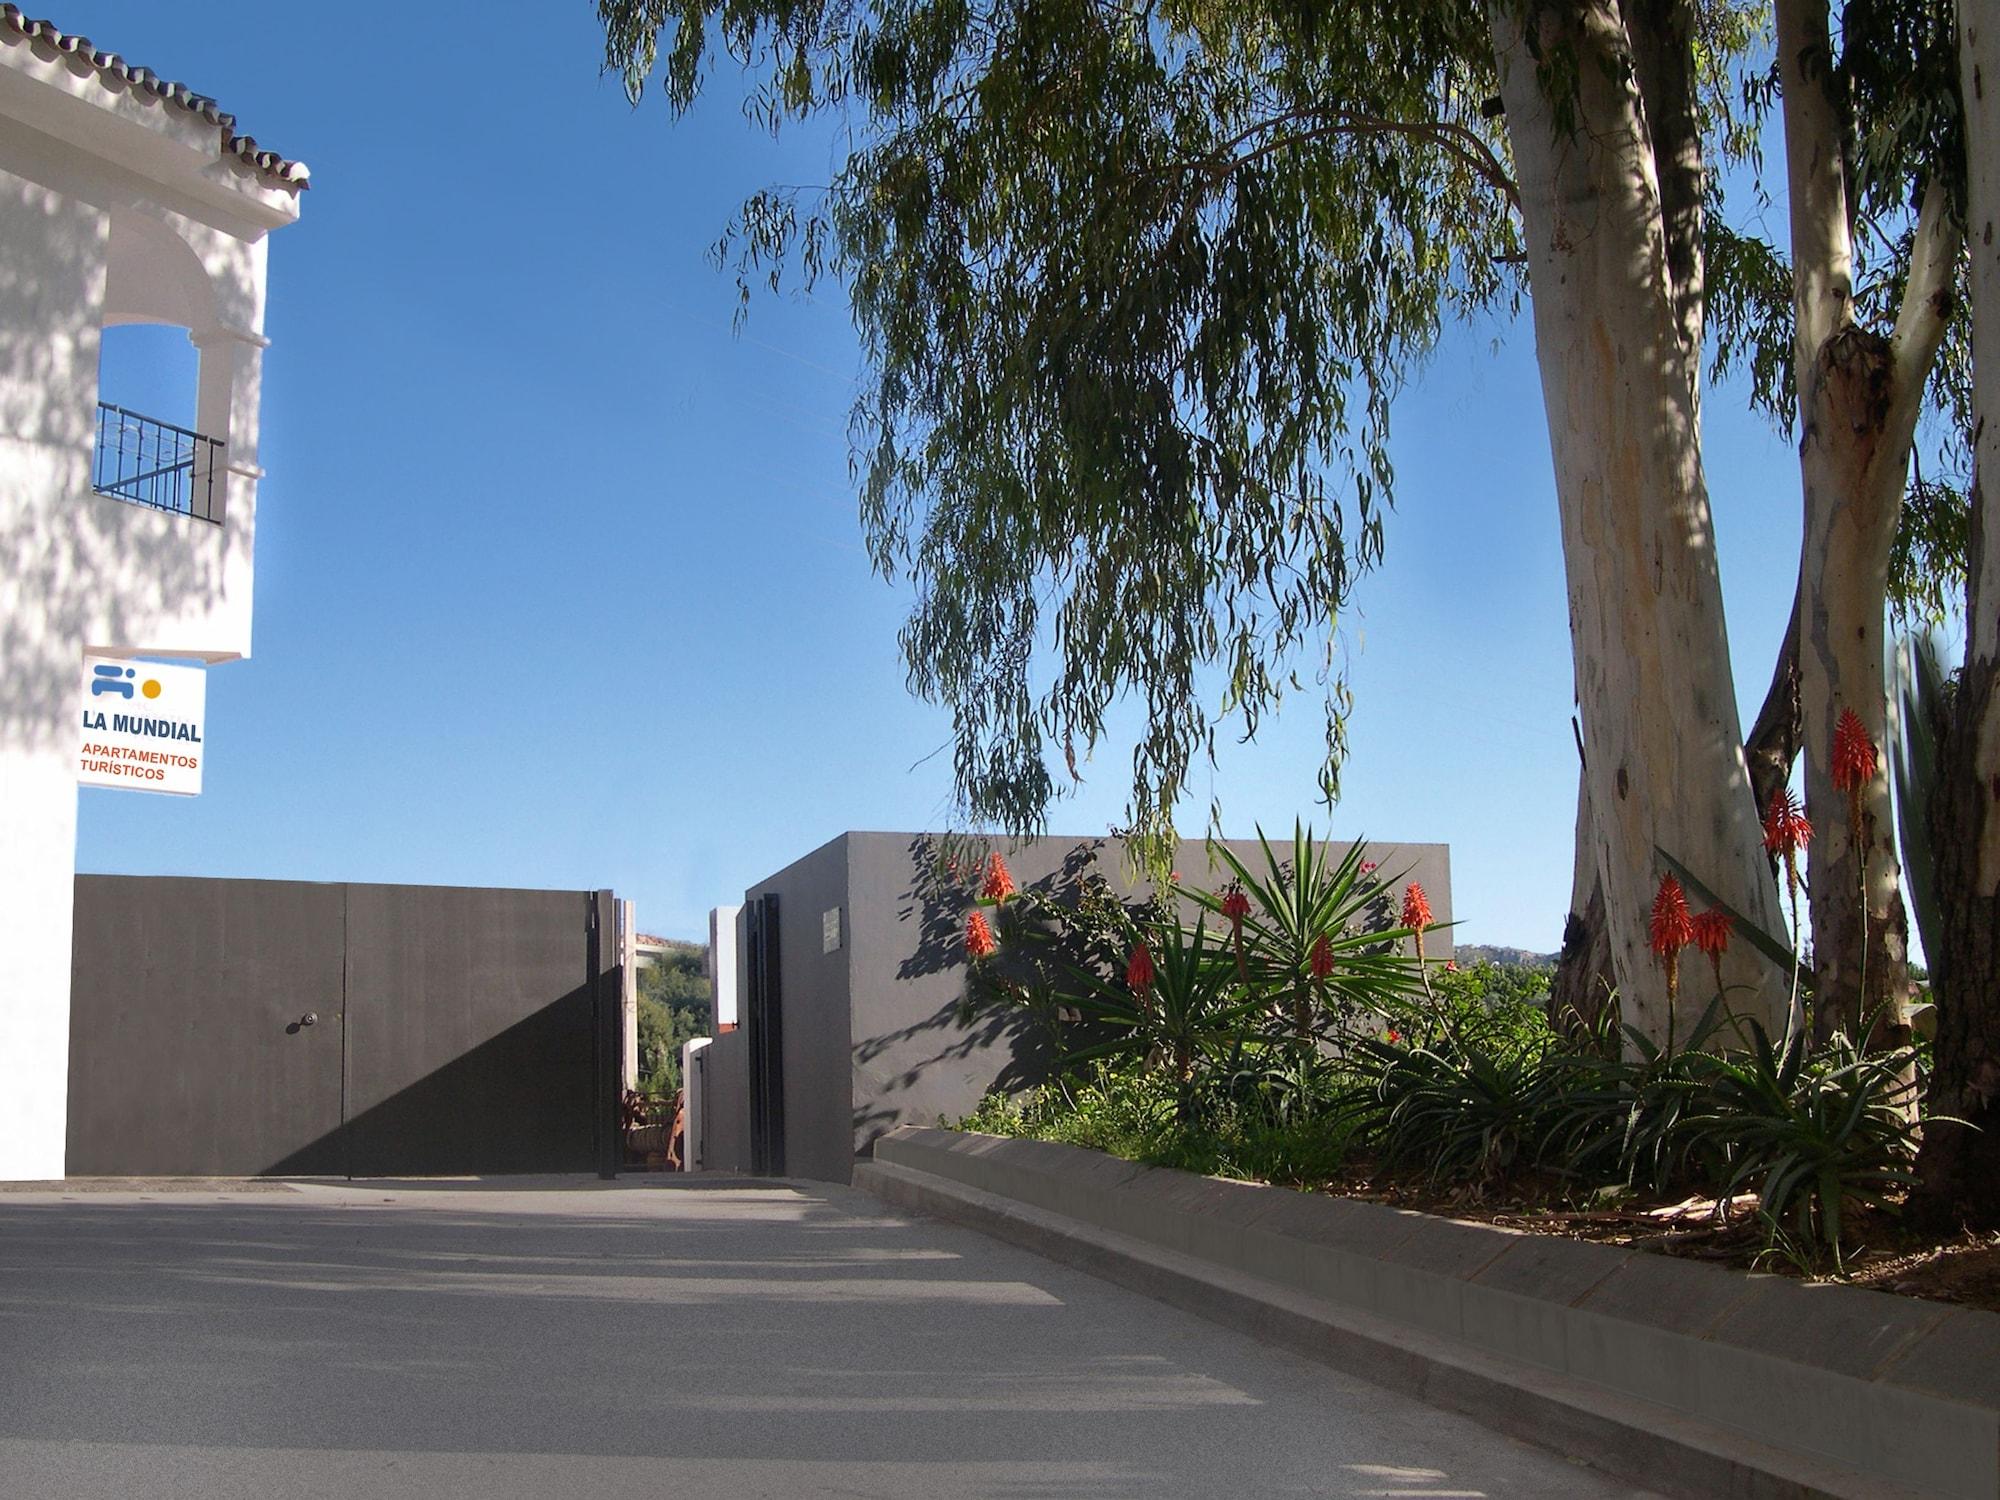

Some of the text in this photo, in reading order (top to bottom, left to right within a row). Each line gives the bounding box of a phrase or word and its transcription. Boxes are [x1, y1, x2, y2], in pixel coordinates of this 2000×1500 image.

[83, 710, 201, 742] LA MUNDIAL
[82, 743, 197, 768] APARTAMENTOS
[80, 759, 165, 780] TURÍSTICOS
